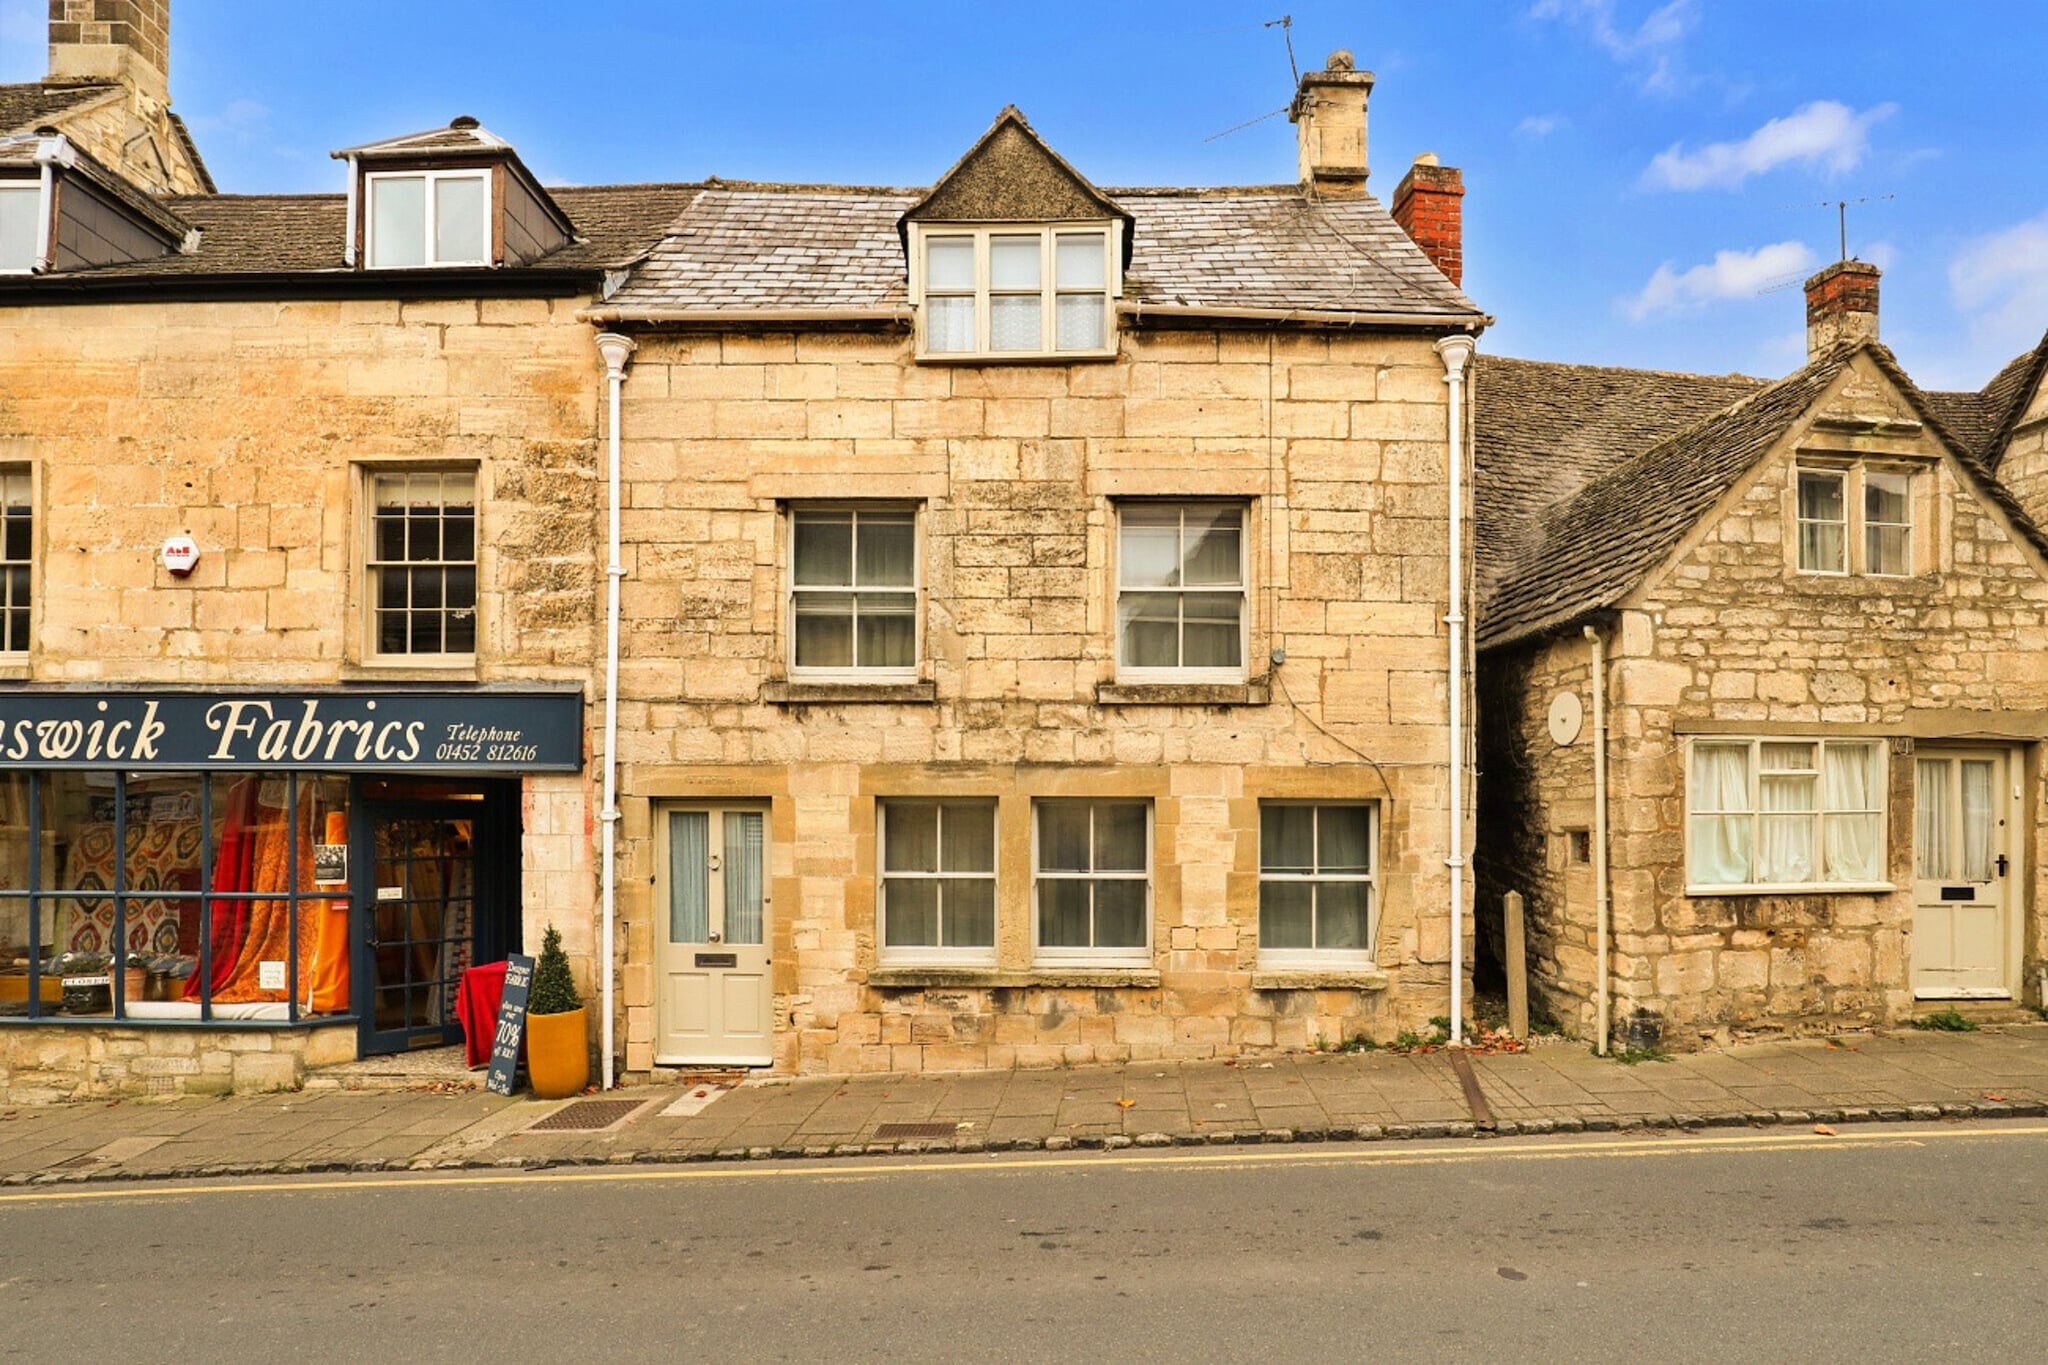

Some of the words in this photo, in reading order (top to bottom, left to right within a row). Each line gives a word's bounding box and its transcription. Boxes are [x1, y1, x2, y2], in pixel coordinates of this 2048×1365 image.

[0, 700, 165, 761] swick
[205, 700, 425, 761] Fabrics
[447, 722, 521, 745] Telephone
[436, 743, 481, 761] 01452
[486, 744, 538, 761] 812616
[496, 1020, 521, 1047] 70%
